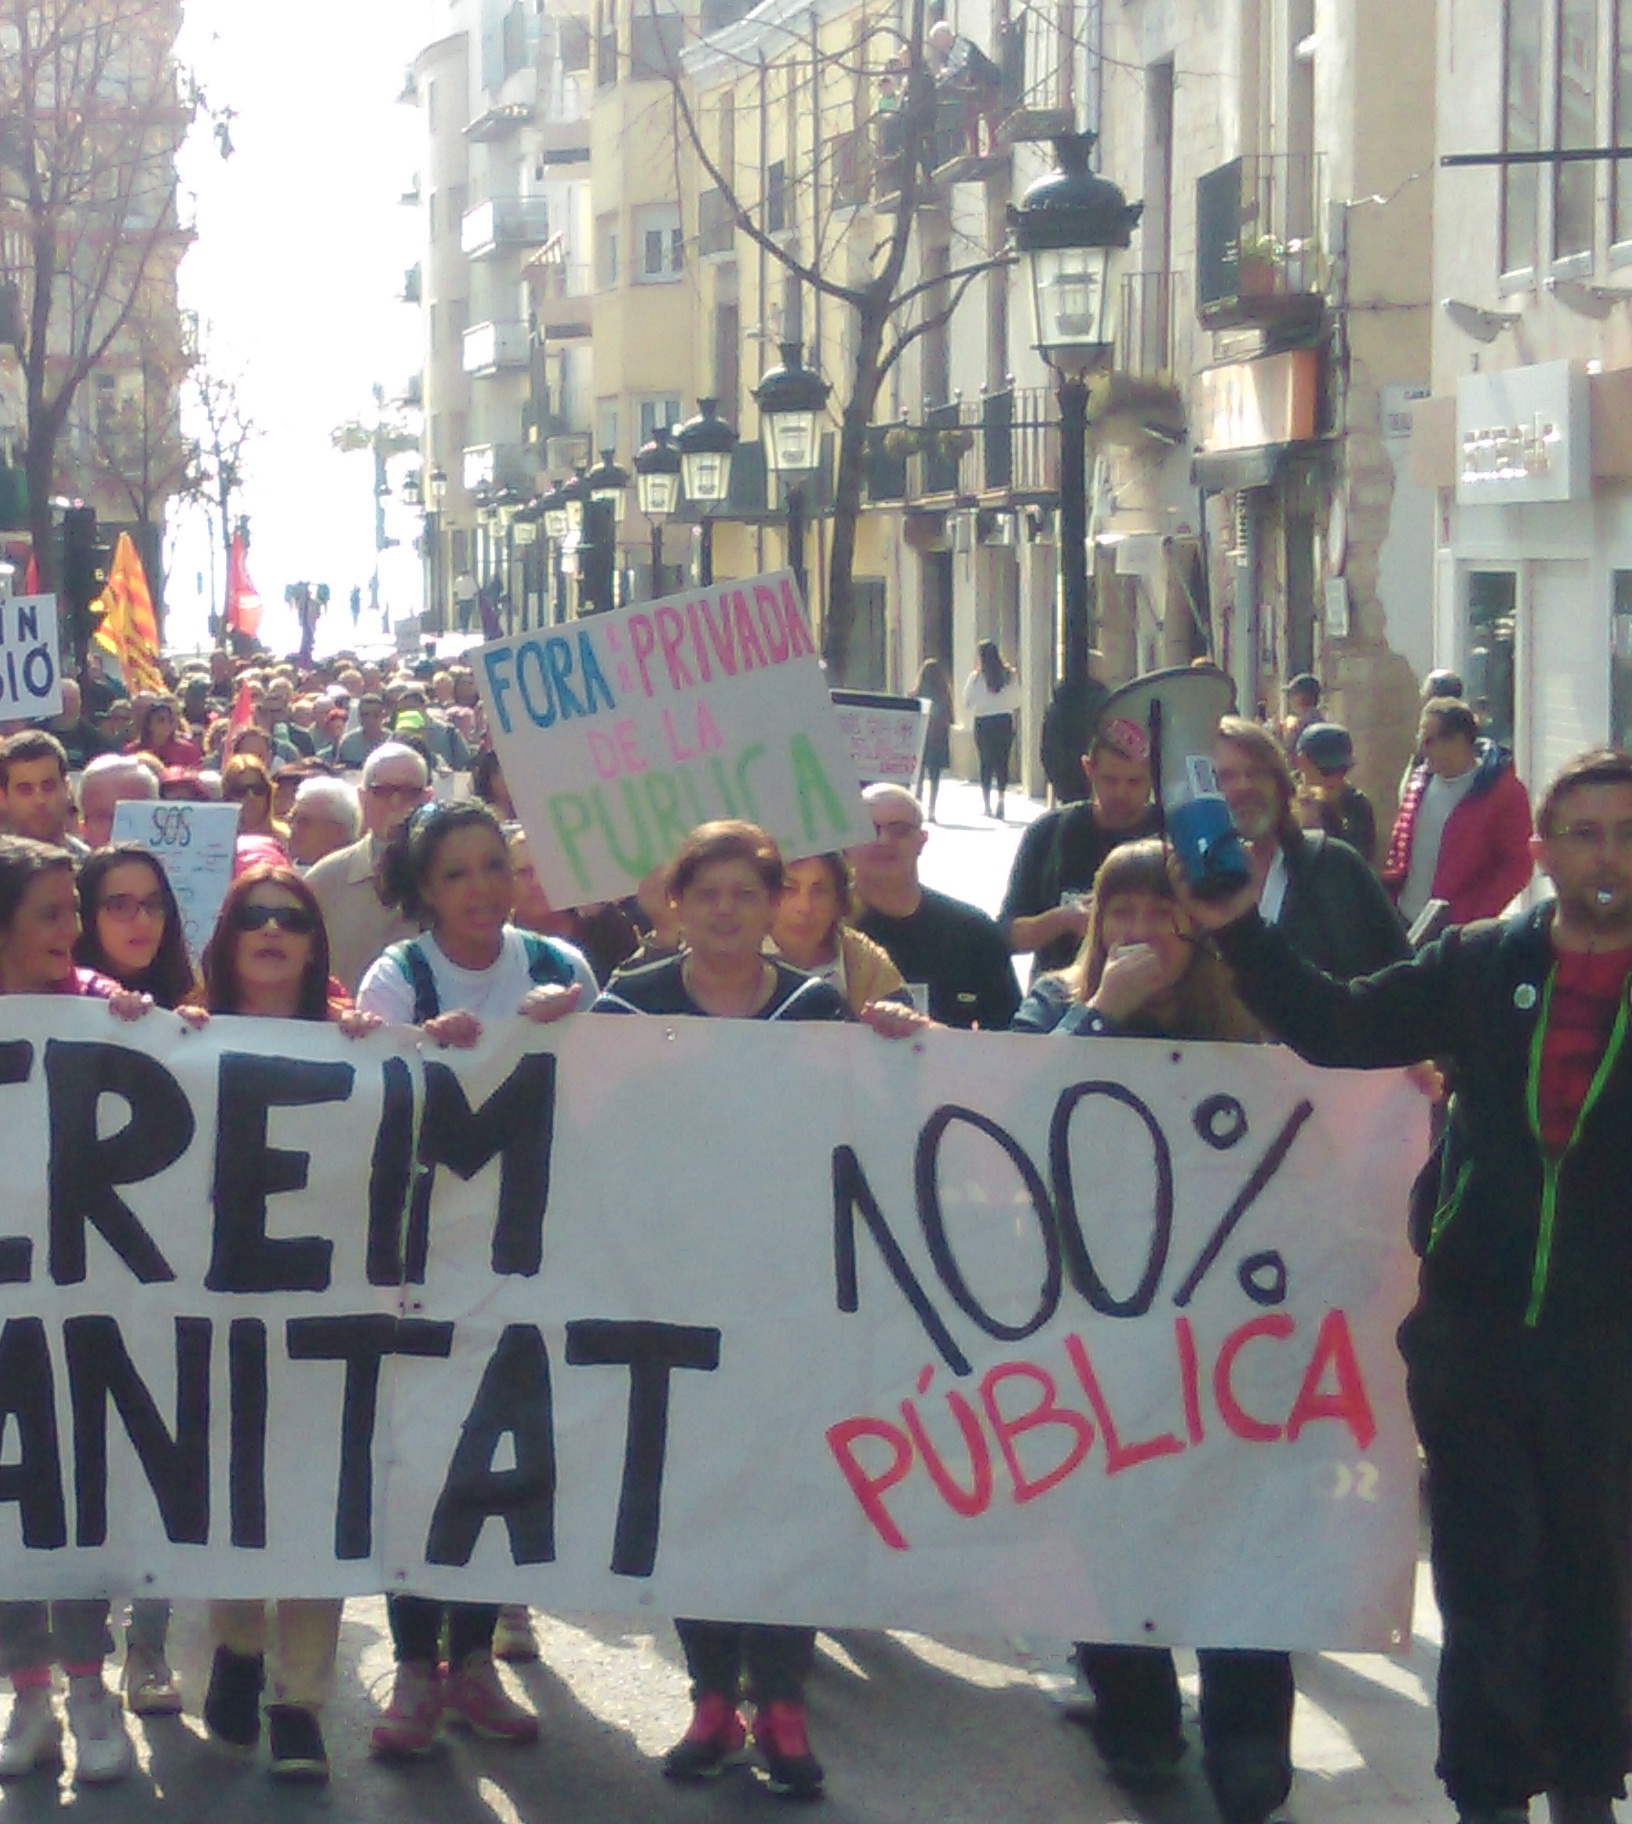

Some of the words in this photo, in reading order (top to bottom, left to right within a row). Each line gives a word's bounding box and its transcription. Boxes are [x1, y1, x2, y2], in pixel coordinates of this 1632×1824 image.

[484, 630, 616, 733] FORA
[627, 580, 814, 697] PRIVADA
[587, 719, 647, 780] DE
[663, 700, 724, 762] LA
[149, 806, 194, 847] SOS
[832, 1079, 1314, 1378] 100%
[826, 1308, 1377, 1551] PÚBLICA
